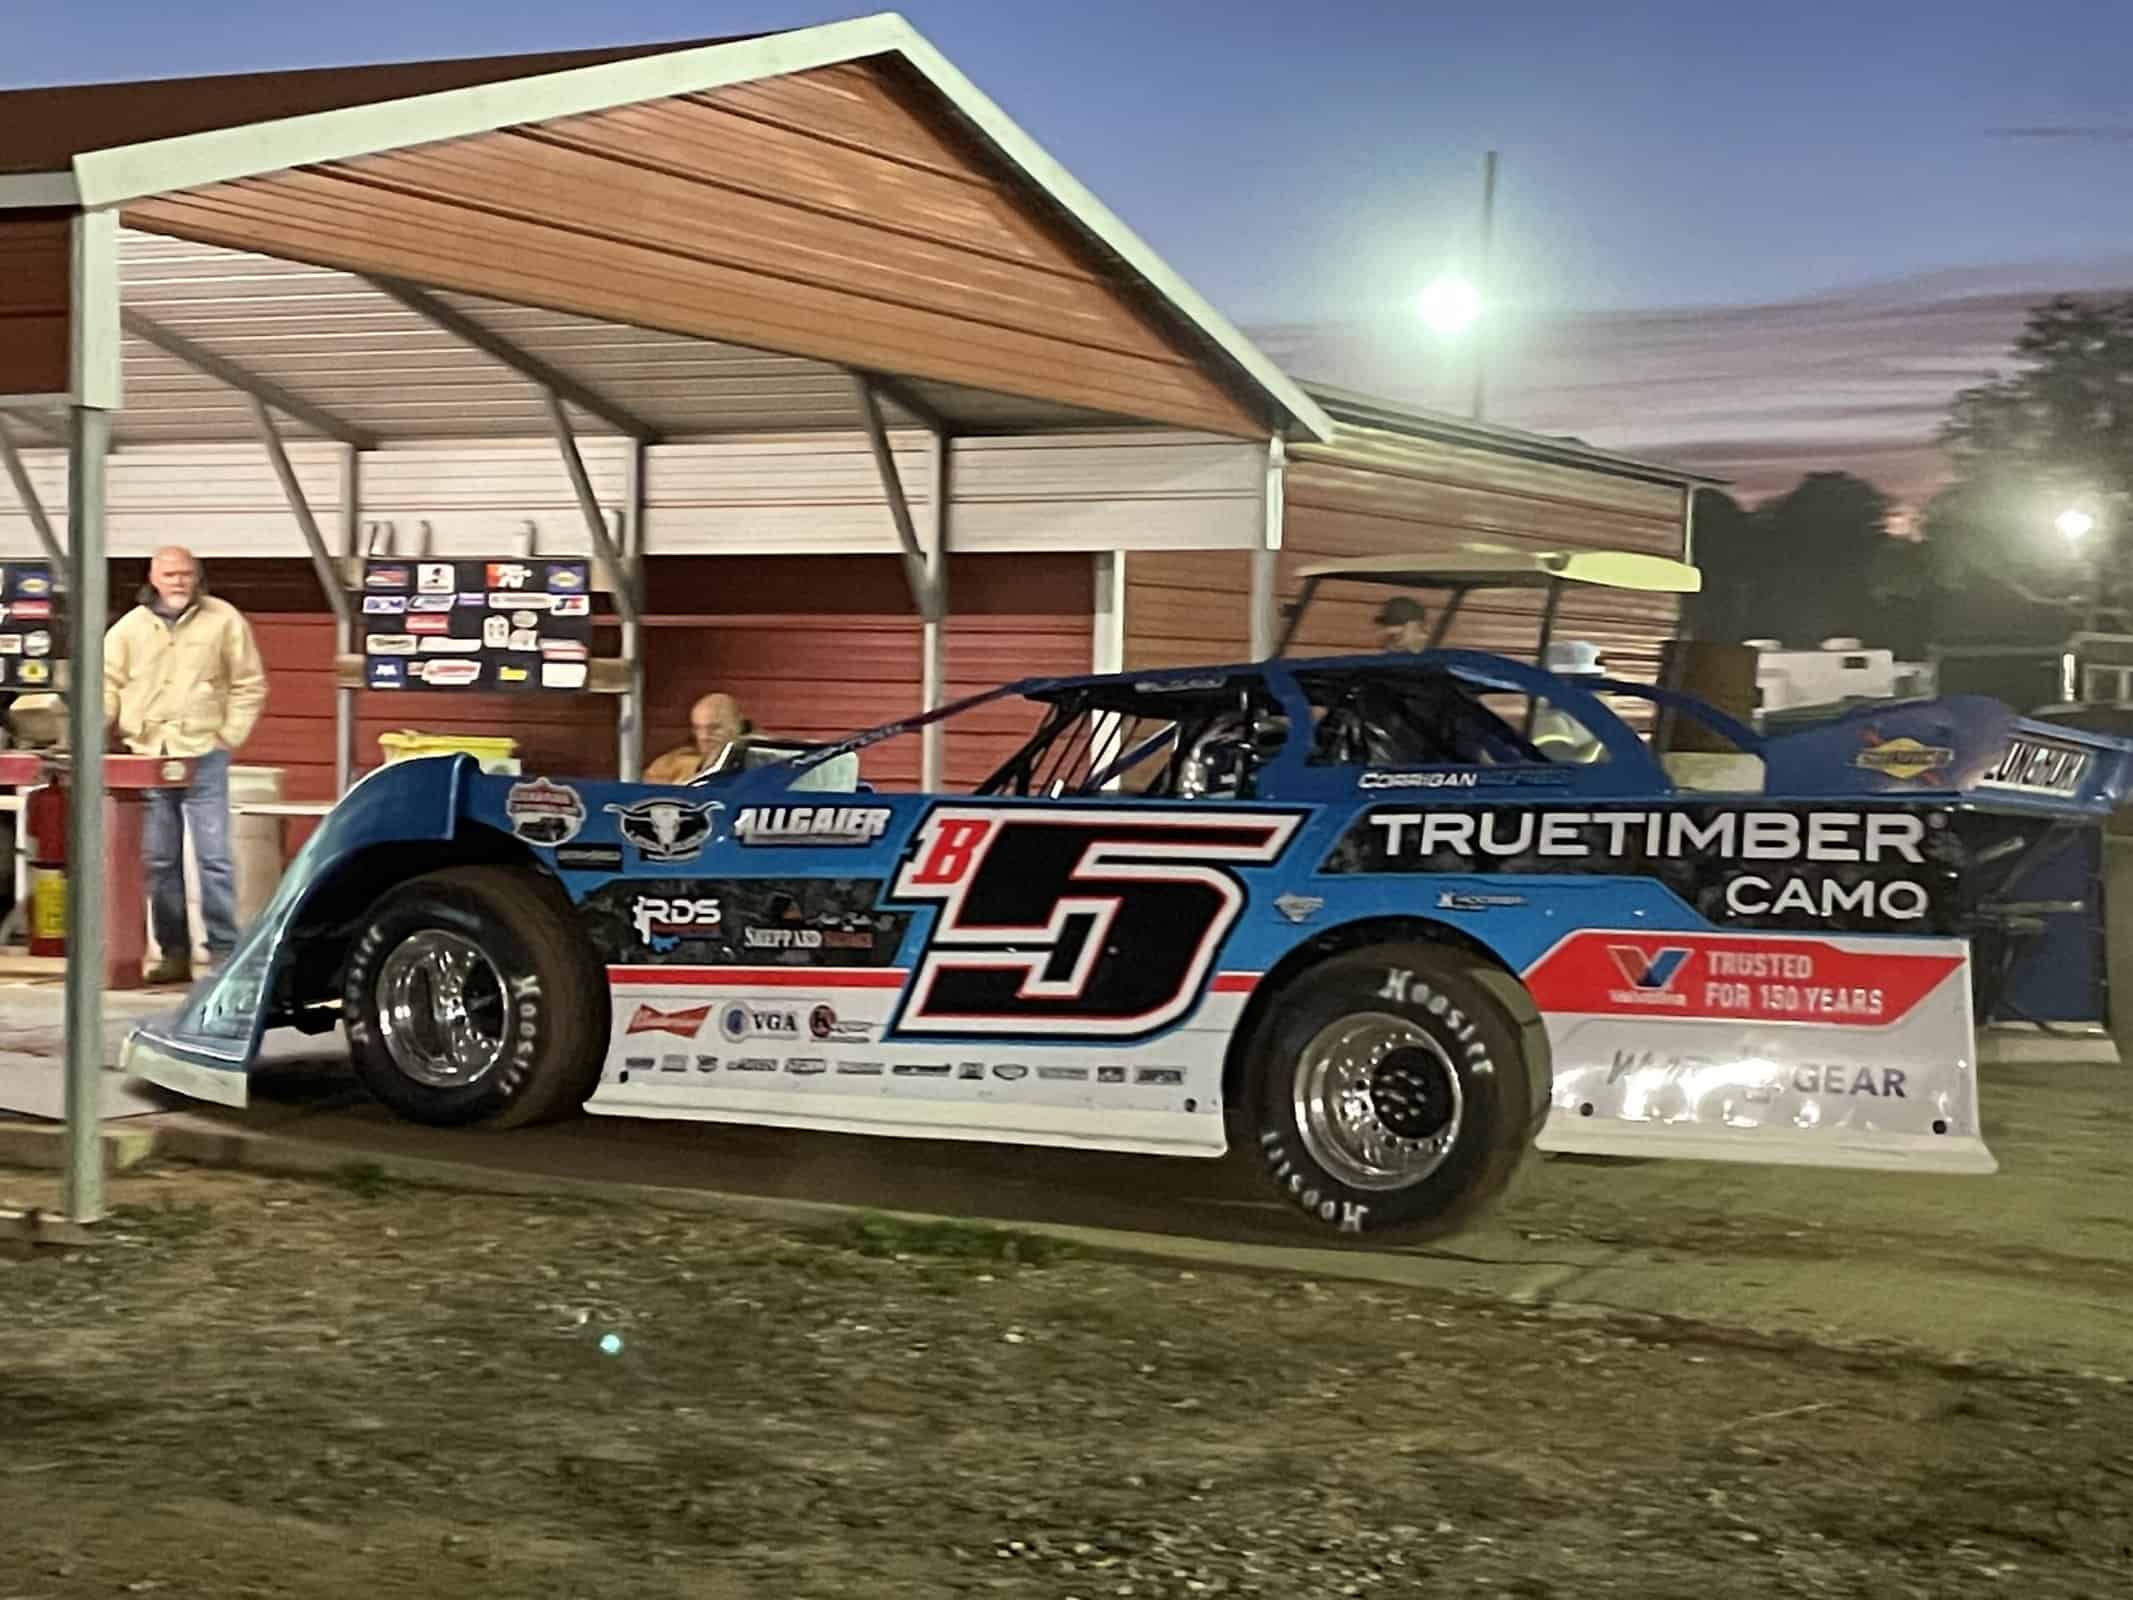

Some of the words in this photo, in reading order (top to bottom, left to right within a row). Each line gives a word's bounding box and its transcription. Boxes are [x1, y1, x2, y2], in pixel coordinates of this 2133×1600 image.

[734, 807, 891, 837] ALLGAIER
[1370, 811, 1925, 863] TRUETIMBER
[911, 818, 993, 885] B
[1726, 876, 1928, 919] CAMO
[898, 808, 1302, 1032] 5
[1705, 951, 1813, 979] TRUSTED
[1705, 982, 1750, 1009] FOR
[1759, 985, 1799, 1012] 150
[1804, 987, 1884, 1015] YEARS
[752, 1013, 799, 1032] VGA
[1792, 1063, 1908, 1099] GEAR
